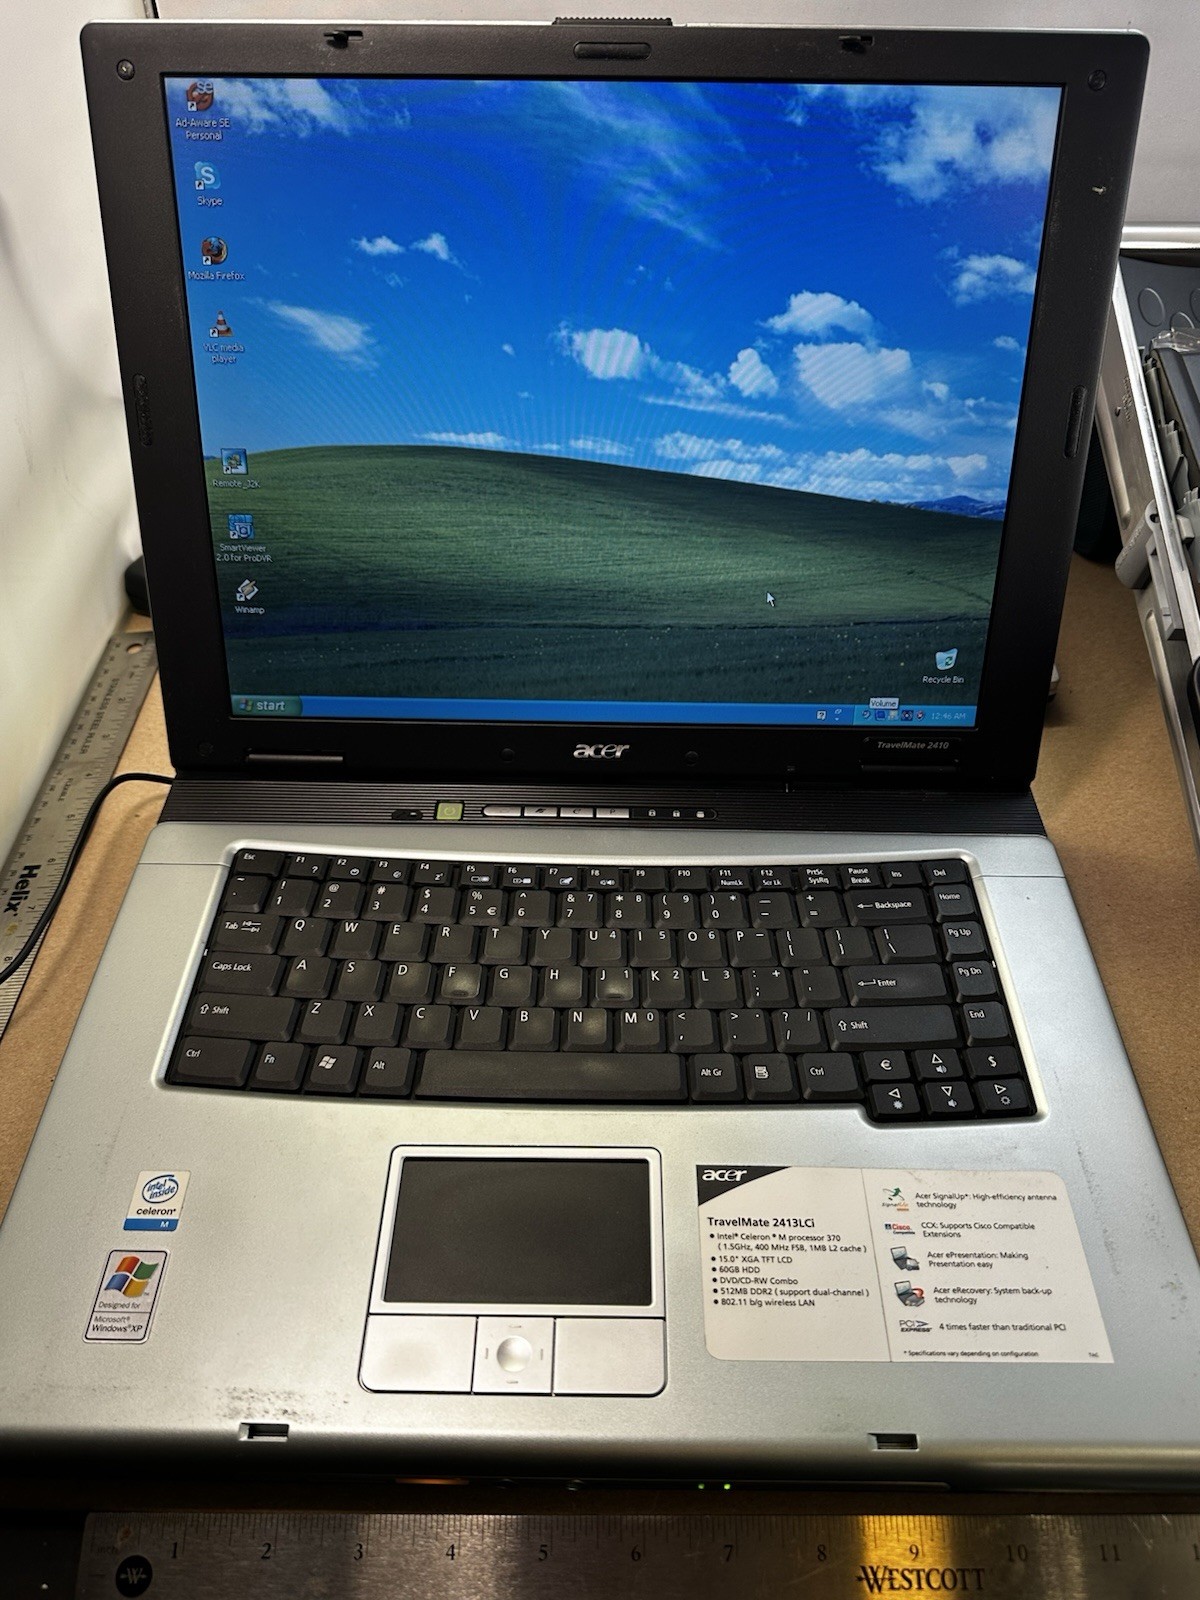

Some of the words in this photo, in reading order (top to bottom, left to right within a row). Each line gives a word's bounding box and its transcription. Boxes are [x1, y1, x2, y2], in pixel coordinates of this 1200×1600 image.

[175, 118, 217, 128] Ad-Aware
[219, 118, 230, 128] SE
[185, 130, 222, 141] Personal
[197, 196, 223, 207] Skype
[188, 271, 215, 280] Mozilla
[216, 271, 245, 281] Firefox
[203, 343, 219, 352] VLC
[220, 343, 244, 352] media
[211, 354, 237, 364] player
[216, 553, 230, 562] 2.0
[230, 554, 242, 562] for
[235, 605, 265, 615] Winamp
[922, 675, 951, 684] Recycle
[256, 701, 286, 711] start
[870, 699, 897, 708] Volume
[931, 712, 952, 720] 12:46
[953, 712, 966, 720] AM
[877, 741, 926, 750] TravelMate
[926, 741, 949, 749] 2410
[572, 743, 630, 759] acer
[3, 864, 41, 912] Helix
[875, 901, 911, 909] Backspace
[948, 929, 959, 937] Pg
[960, 928, 971, 937] Up
[212, 962, 232, 971] Caps
[233, 963, 251, 971] Lock
[958, 968, 970, 977] Pg
[212, 1006, 229, 1014] Shift
[969, 1010, 985, 1018] End
[850, 1021, 868, 1029] Shift
[186, 1049, 201, 1057] Ctrl
[264, 1054, 275, 1063] Fn
[372, 1061, 385, 1069] Alt
[713, 1068, 722, 1076] Gr
[810, 1067, 824, 1075] Ctrl
[702, 1168, 747, 1182] acer
[147, 1179, 166, 1192] intel
[149, 1185, 176, 1199] inside
[972, 1193, 1025, 1202] High-efficiency
[916, 1201, 957, 1209] technology
[707, 1217, 769, 1227] TravelMate
[773, 1218, 815, 1228] 2413LCi
[892, 1223, 910, 1231] Cisco
[939, 1223, 972, 1231] Supports
[993, 1222, 1035, 1230] Compatible
[827, 1234, 841, 1242] 370
[923, 1230, 961, 1238] Extensions
[755, 1243, 769, 1251] 400
[791, 1244, 807, 1252] FSB,
[777, 1256, 793, 1264] LCD
[945, 1251, 997, 1259] ePresentation:
[1000, 1252, 1029, 1261] Making
[770, 1277, 798, 1285] Combo
[721, 1287, 748, 1295] 512MB
[779, 1289, 811, 1297] support
[952, 1287, 992, 1296] eRecovery:
[994, 1287, 1020, 1296] System
[1021, 1287, 1052, 1296] back-up
[721, 1298, 747, 1306] 802.11
[749, 1299, 763, 1308] b/g
[934, 1296, 977, 1305] technology
[98, 1301, 130, 1310] Designed
[939, 1323, 945, 1331] 4
[1053, 1323, 1066, 1331] PCI
[170, 1541, 179, 1560] 1
[260, 1542, 272, 1560] 2
[353, 1543, 364, 1561] 3
[444, 1543, 456, 1561] 4
[538, 1544, 549, 1562] 5
[630, 1544, 642, 1562] 6
[723, 1544, 734, 1562] 7
[816, 1544, 827, 1562] 8
[908, 1544, 920, 1562] 9
[1006, 1544, 1029, 1562] 10
[1100, 1544, 1121, 1562] 11
[856, 1564, 985, 1593] WESTCOTT
